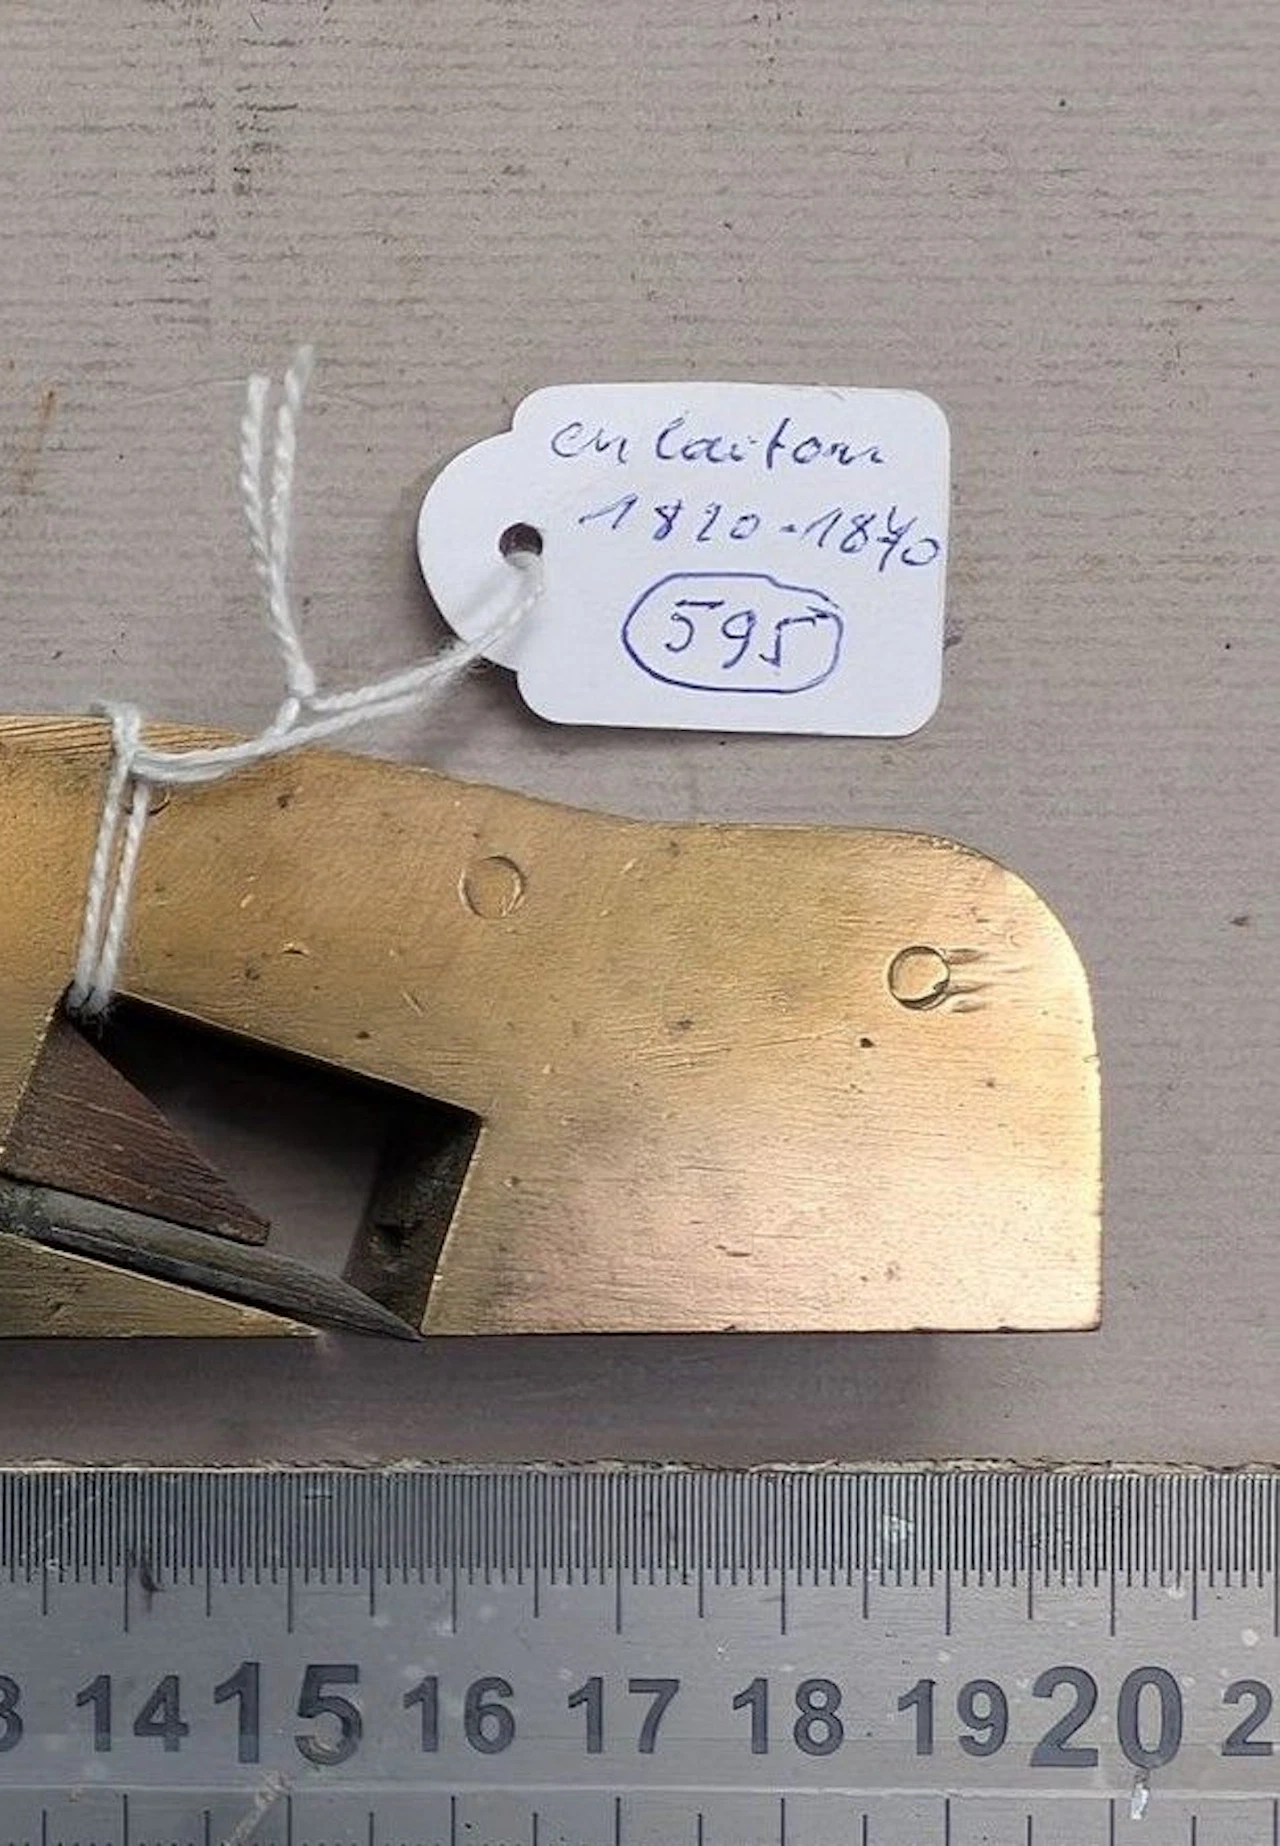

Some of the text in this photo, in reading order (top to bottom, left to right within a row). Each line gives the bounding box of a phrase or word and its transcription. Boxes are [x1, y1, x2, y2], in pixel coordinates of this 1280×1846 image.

[664, 600, 834, 668] 595
[76, 1675, 190, 1752] 14
[213, 1661, 364, 1765] 15
[402, 1676, 516, 1754] 16
[567, 1677, 680, 1754] 17
[732, 1677, 844, 1755] 18
[897, 1679, 1009, 1756] 19
[1030, 1666, 1183, 1768] 20
